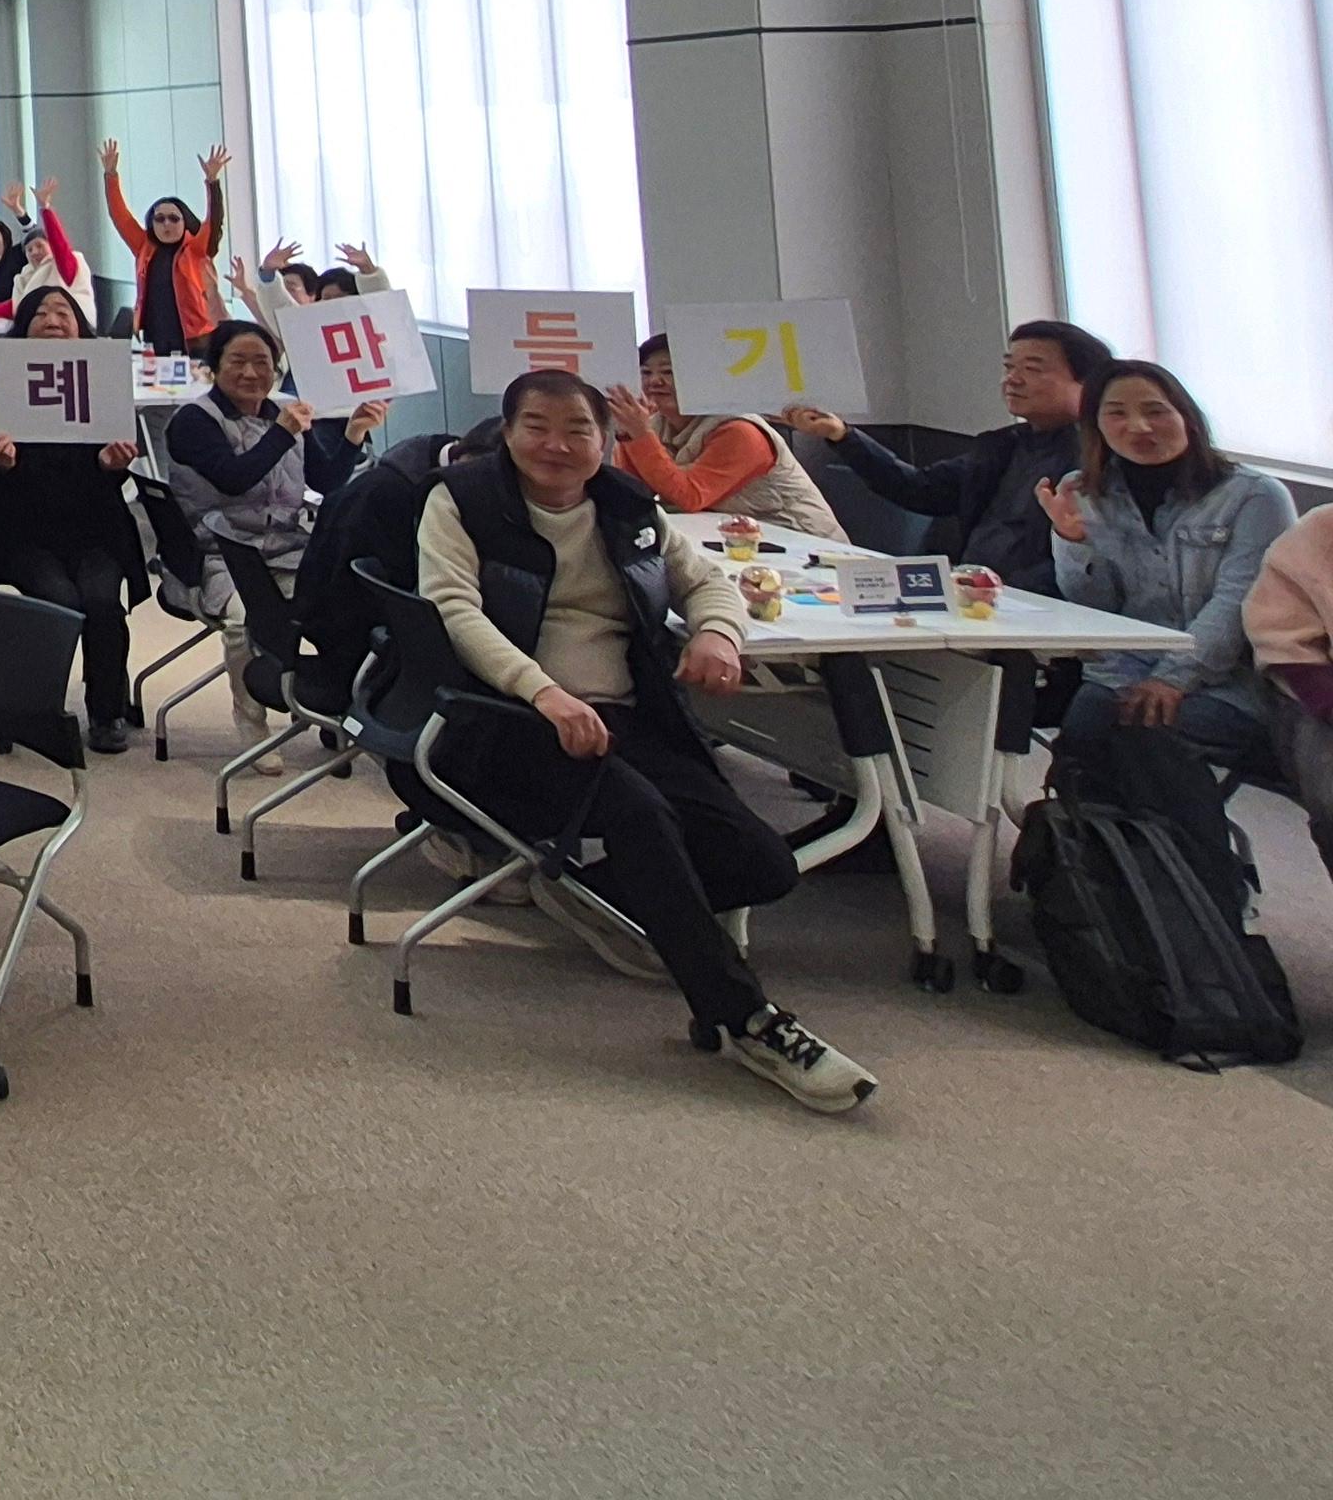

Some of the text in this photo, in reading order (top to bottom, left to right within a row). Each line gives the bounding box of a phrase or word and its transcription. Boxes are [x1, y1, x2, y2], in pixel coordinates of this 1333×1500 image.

[320, 314, 392, 394] 만
[724, 321, 806, 393] 기
[27, 360, 90, 425] 례
